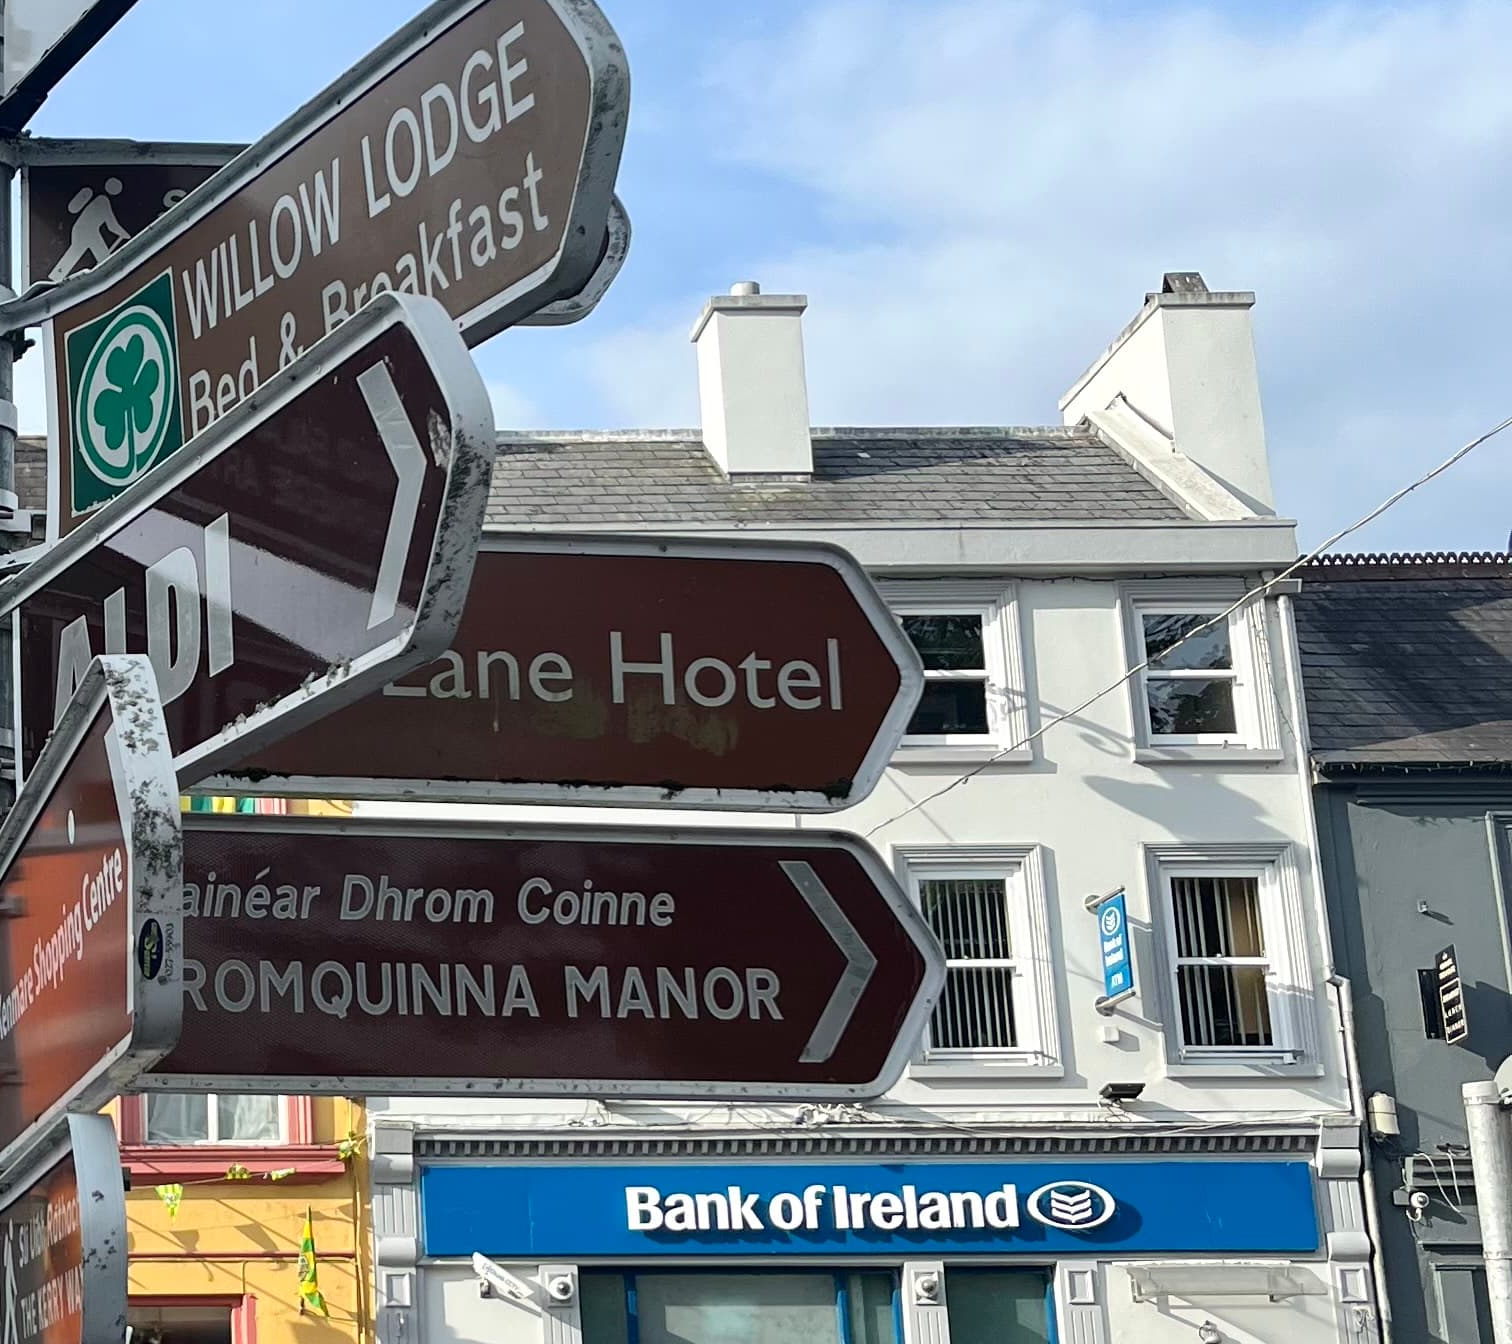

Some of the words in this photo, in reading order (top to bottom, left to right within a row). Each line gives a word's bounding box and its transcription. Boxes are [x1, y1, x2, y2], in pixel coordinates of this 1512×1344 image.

[182, 157, 340, 341] WILLOW
[360, 20, 536, 219] LODGE
[189, 335, 259, 436] Bed
[382, 646, 574, 701] ane
[609, 630, 843, 711] Hotel
[33, 899, 85, 997] Shopping
[81, 846, 124, 933] Centre
[339, 872, 494, 924] Dhrom
[516, 875, 676, 928] Coinne
[564, 963, 784, 1021] MANOR
[624, 1183, 765, 1232] Bank
[768, 1184, 826, 1231] of
[832, 1182, 1021, 1230] Ireland
[20, 1292, 38, 1339] THE
[37, 1274, 64, 1330] KERRY
[64, 1263, 83, 1315] WA
